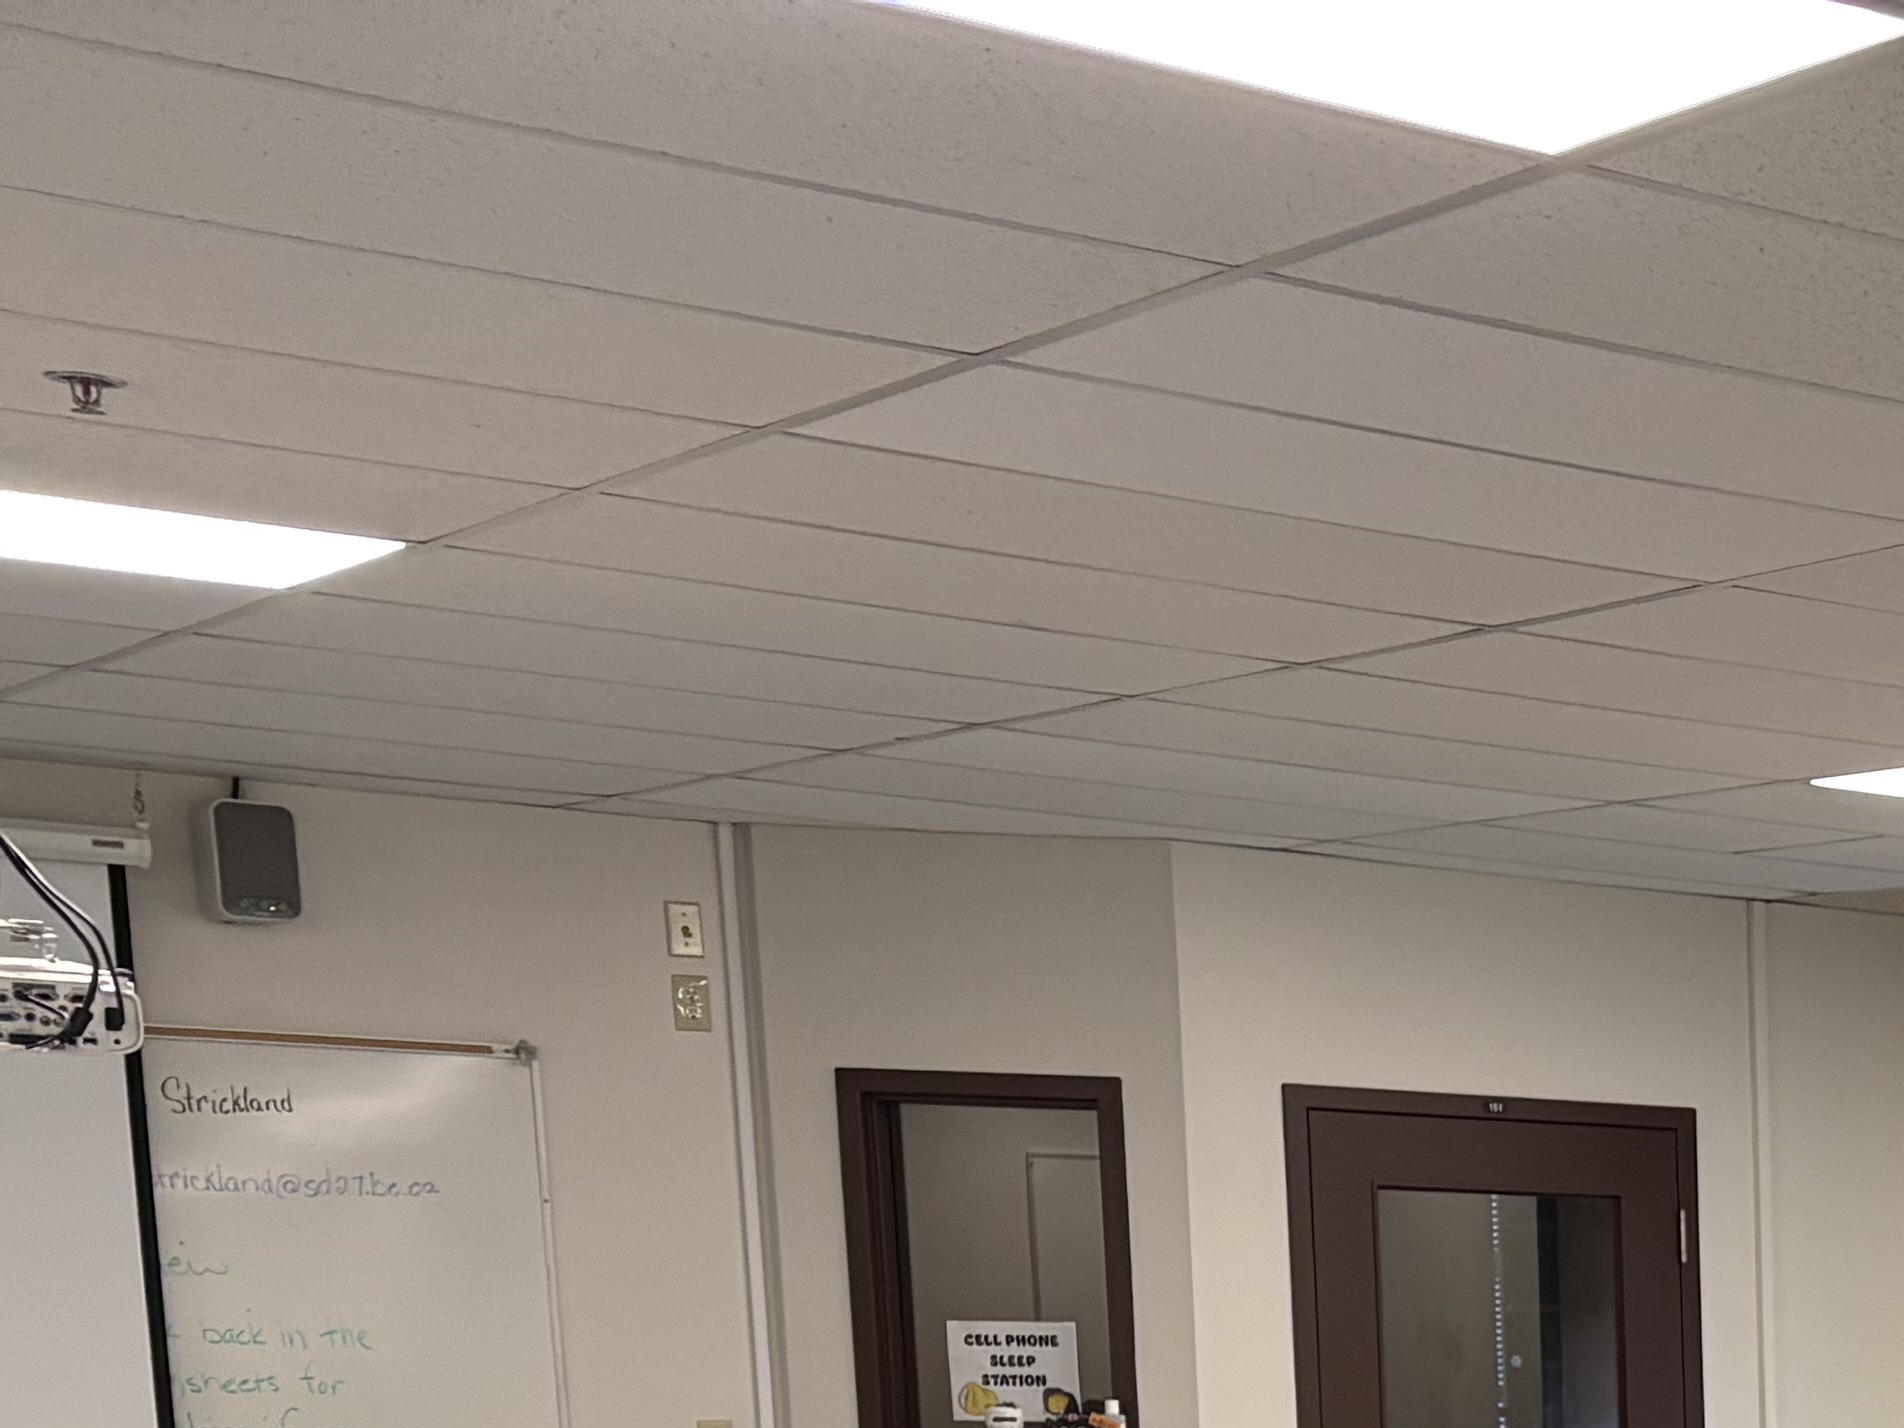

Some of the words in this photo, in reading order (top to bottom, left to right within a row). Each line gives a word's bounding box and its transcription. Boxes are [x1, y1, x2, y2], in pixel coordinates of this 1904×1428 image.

[160, 1076, 293, 1115] Strickland
[280, 1326, 308, 1349] in
[964, 1334, 1002, 1347] CELL
[1005, 1334, 1059, 1348] PHONE
[989, 1354, 1036, 1368] SLEEP
[300, 1361, 344, 1395] for
[981, 1373, 1047, 1387] STATION
